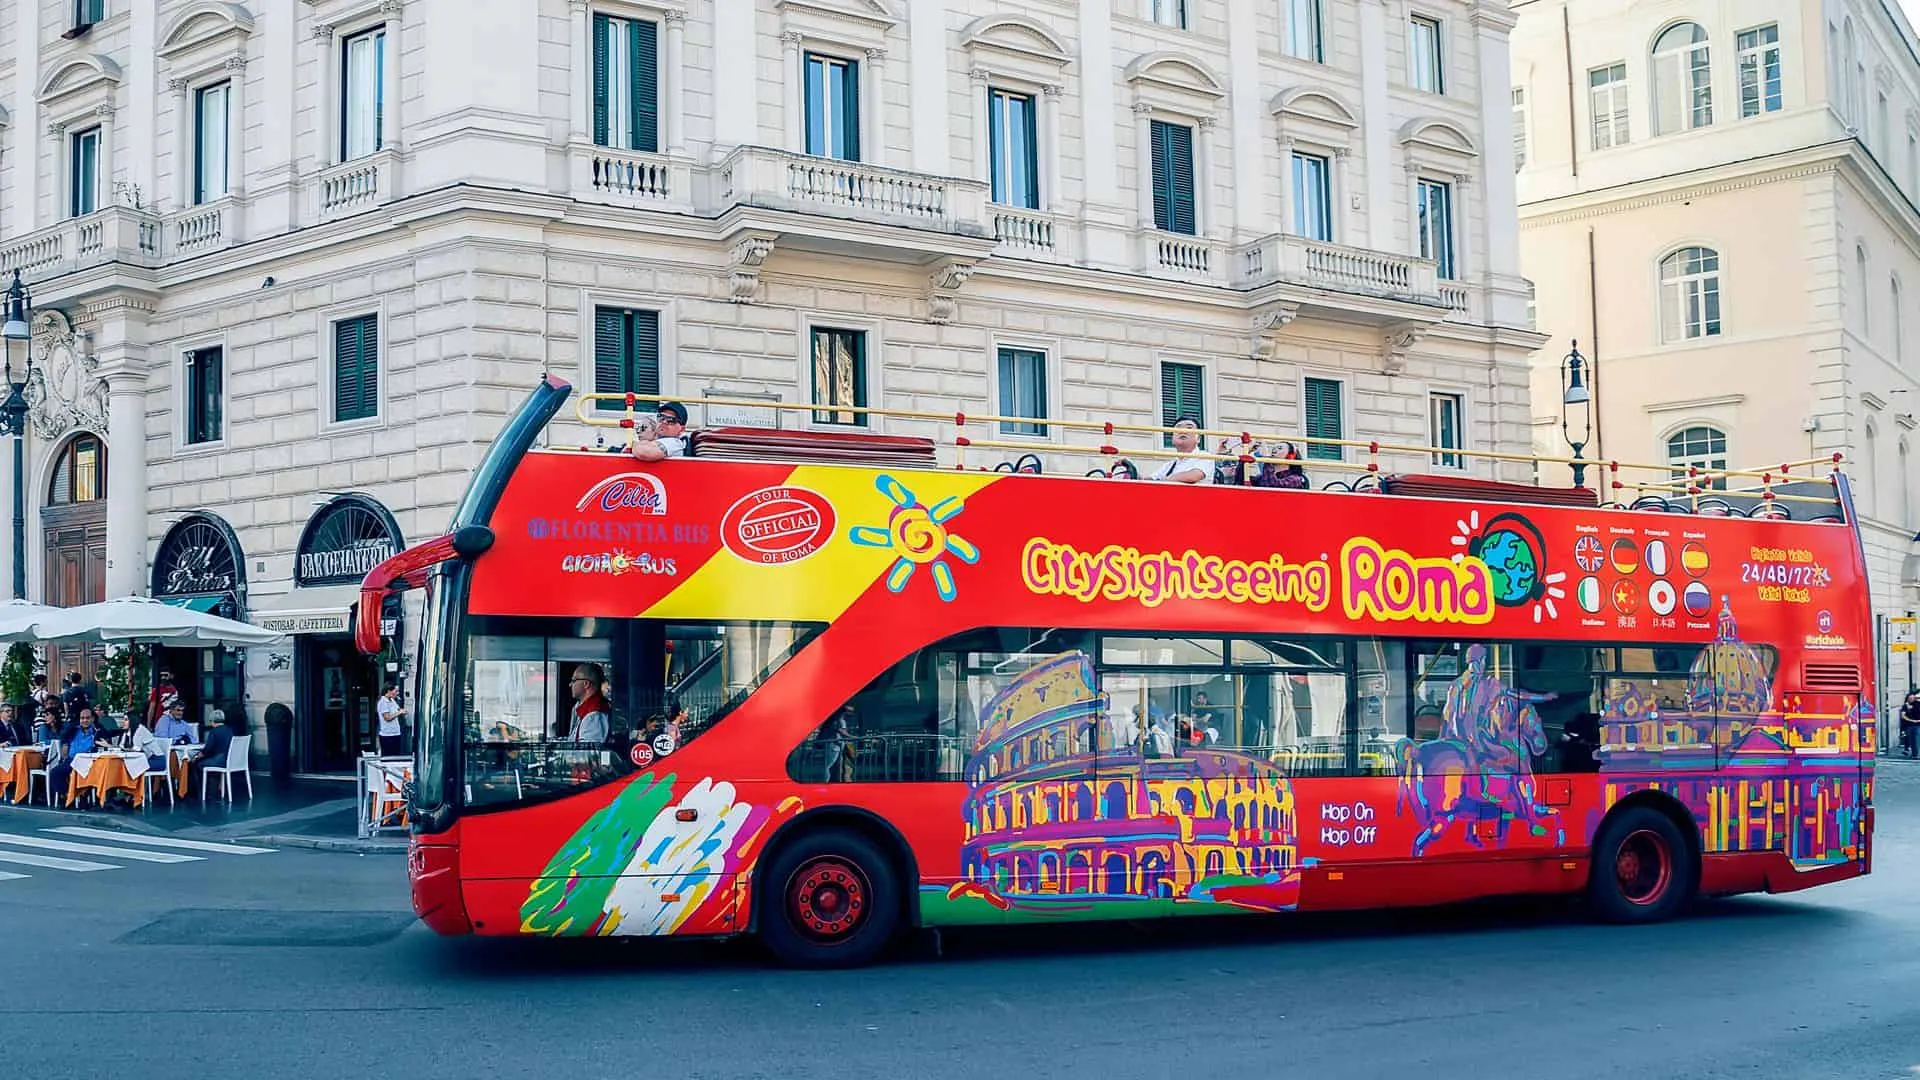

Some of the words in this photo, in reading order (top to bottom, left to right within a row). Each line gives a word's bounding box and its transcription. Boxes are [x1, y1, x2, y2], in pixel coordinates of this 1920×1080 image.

[601, 481, 661, 512] Cilia
[753, 489, 792, 505] TOUR
[551, 518, 668, 544] FLORENTIA
[673, 524, 710, 545] BUS
[742, 513, 818, 539] OFFICIAL
[762, 552, 780, 563] OF
[782, 543, 817, 562] ROMA
[301, 552, 324, 578] BAR
[634, 750, 652, 759] 105
[1321, 803, 1351, 823] Hop
[1354, 802, 1374, 821] On
[1321, 826, 1350, 846] Hop
[1353, 825, 1377, 844] Off
